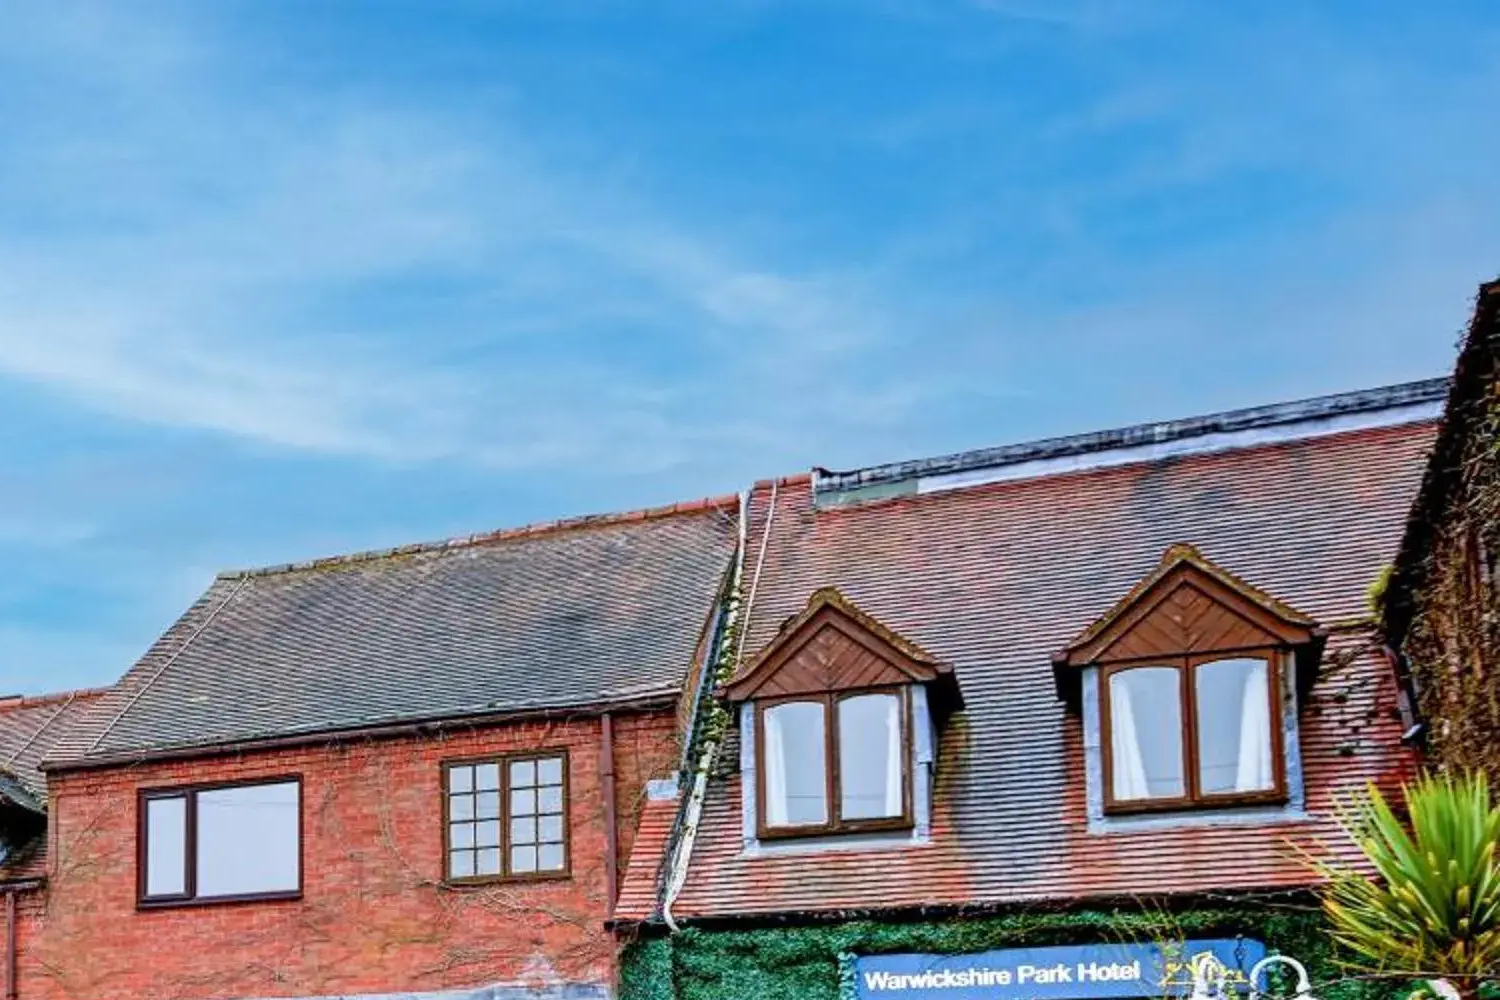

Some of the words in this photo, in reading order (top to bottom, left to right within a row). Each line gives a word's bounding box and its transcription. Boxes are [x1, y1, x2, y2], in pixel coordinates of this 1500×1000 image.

[864, 967, 1012, 991] Warwickshire
[1017, 964, 1072, 985] Park
[1077, 960, 1141, 983] Hotel
